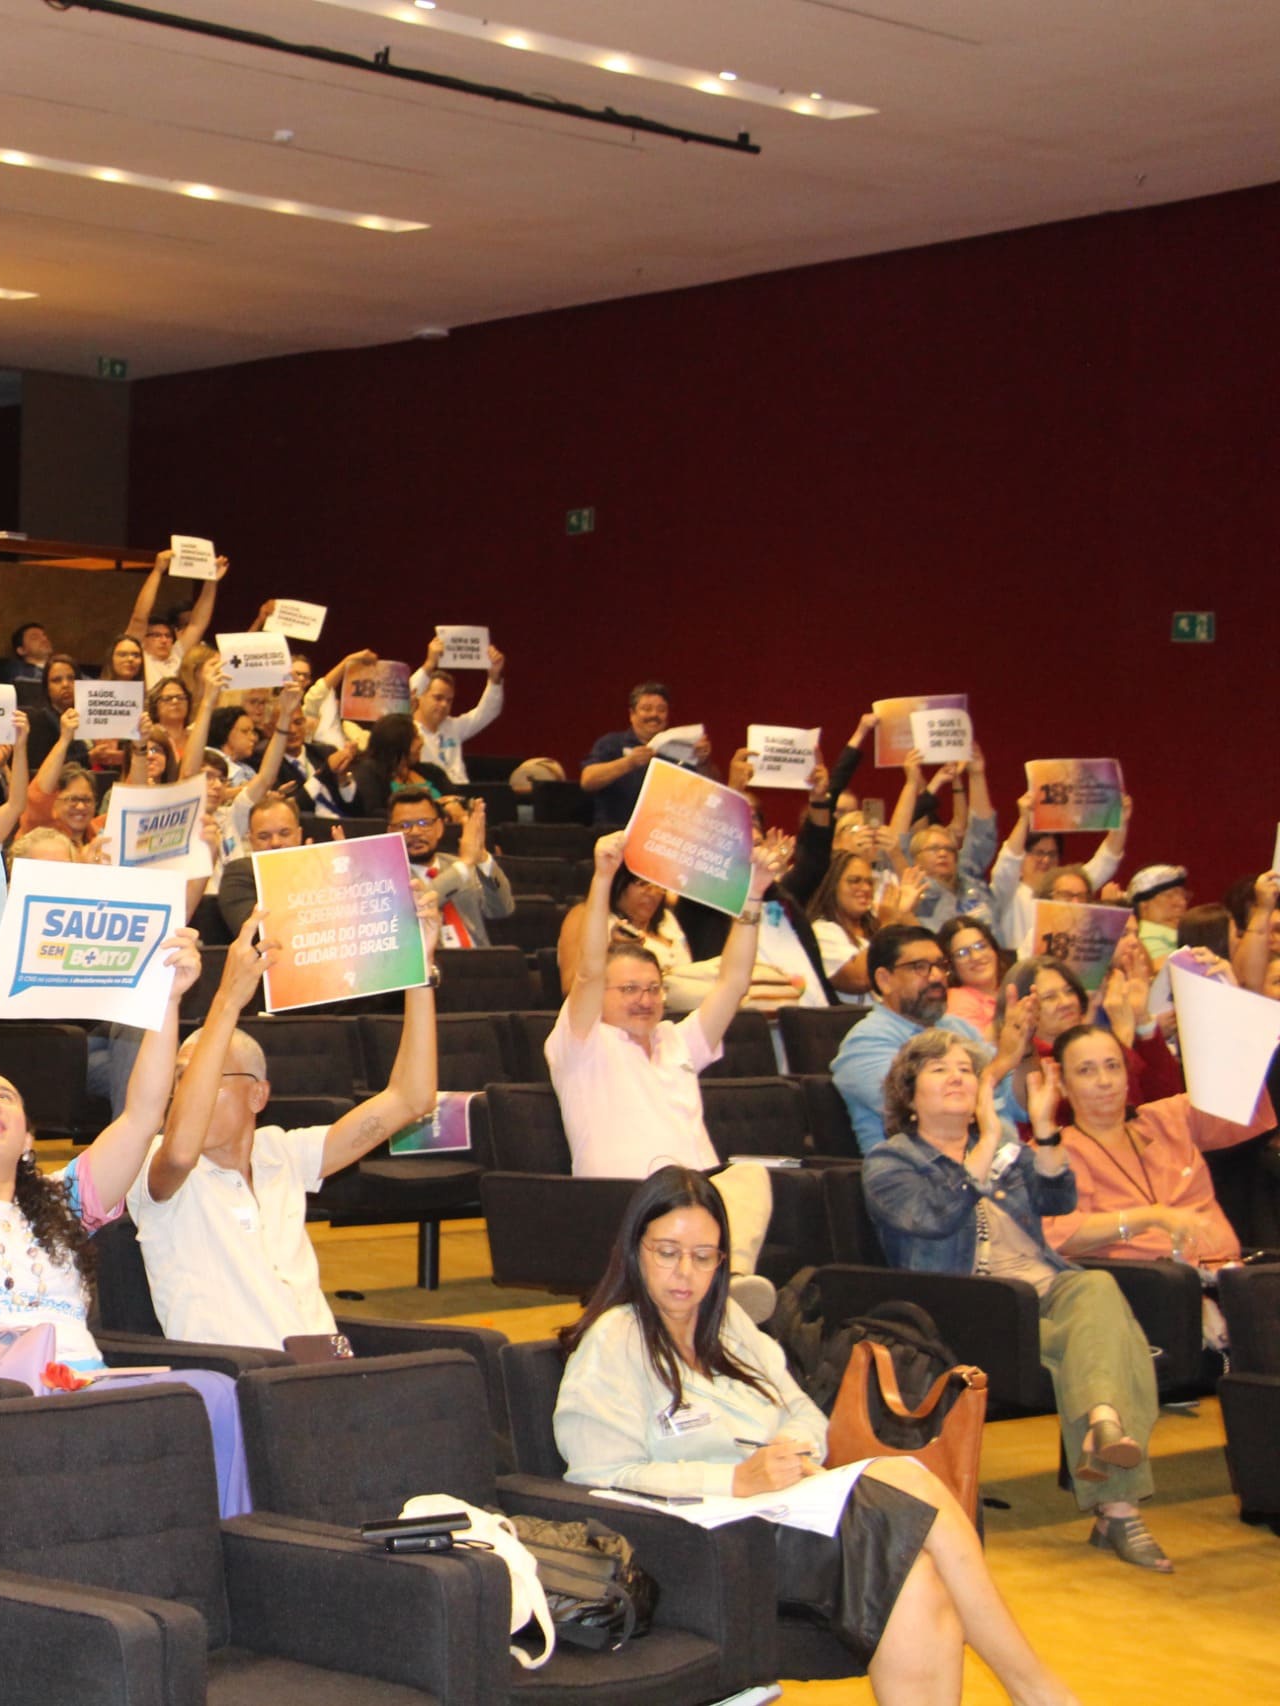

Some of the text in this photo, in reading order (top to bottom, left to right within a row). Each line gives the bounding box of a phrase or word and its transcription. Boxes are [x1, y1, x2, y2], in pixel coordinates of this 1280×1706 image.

[370, 896, 392, 913] SUS
[41, 901, 150, 943] SAÚDE
[291, 914, 399, 949] CUIDAR DO POVO É
[39, 944, 65, 957] SEM
[293, 936, 400, 966] CUIDAR DO BRASIL
